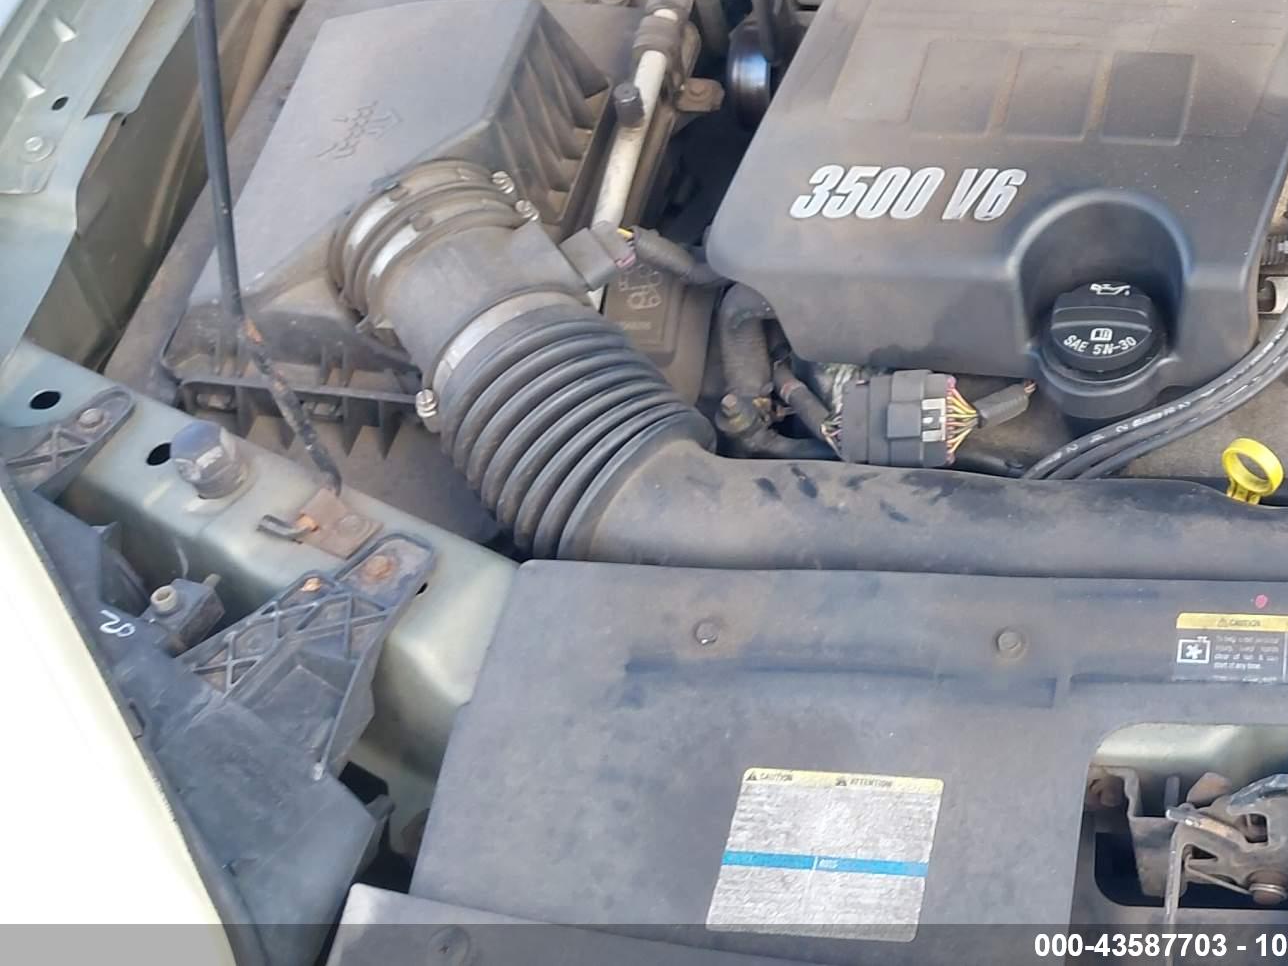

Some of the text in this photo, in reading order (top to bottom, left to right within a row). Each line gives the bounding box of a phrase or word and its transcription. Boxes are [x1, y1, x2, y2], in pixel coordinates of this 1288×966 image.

[789, 165, 1028, 222] 3500 V6
[1063, 335, 1137, 356] SAE 5W-30
